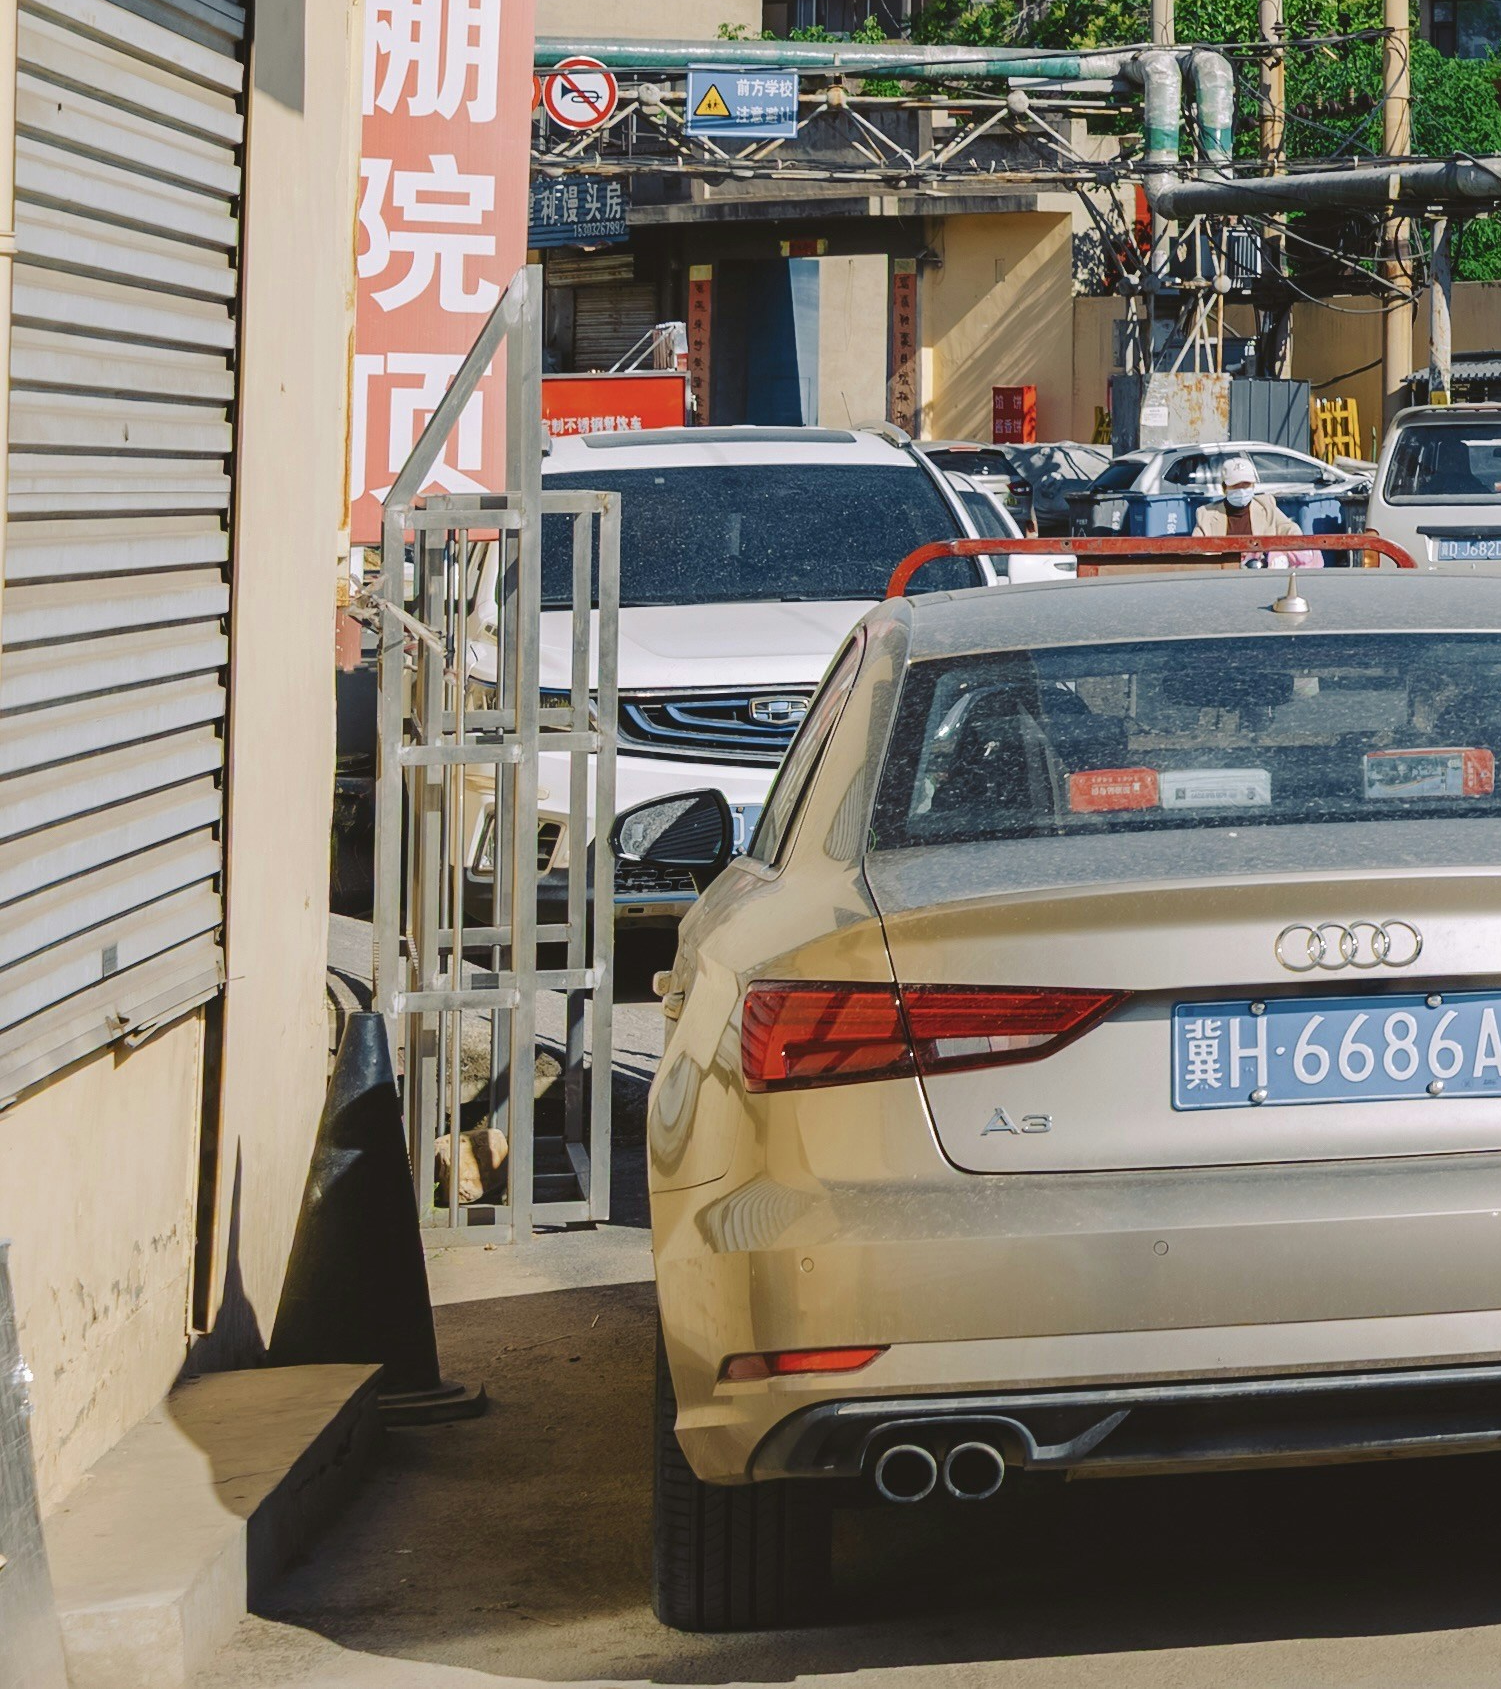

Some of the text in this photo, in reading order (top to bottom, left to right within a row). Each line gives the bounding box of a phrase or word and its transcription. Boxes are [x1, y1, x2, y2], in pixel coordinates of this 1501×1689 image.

[736, 77, 793, 98] 前方学校
[980, 1107, 1053, 1136] A3
